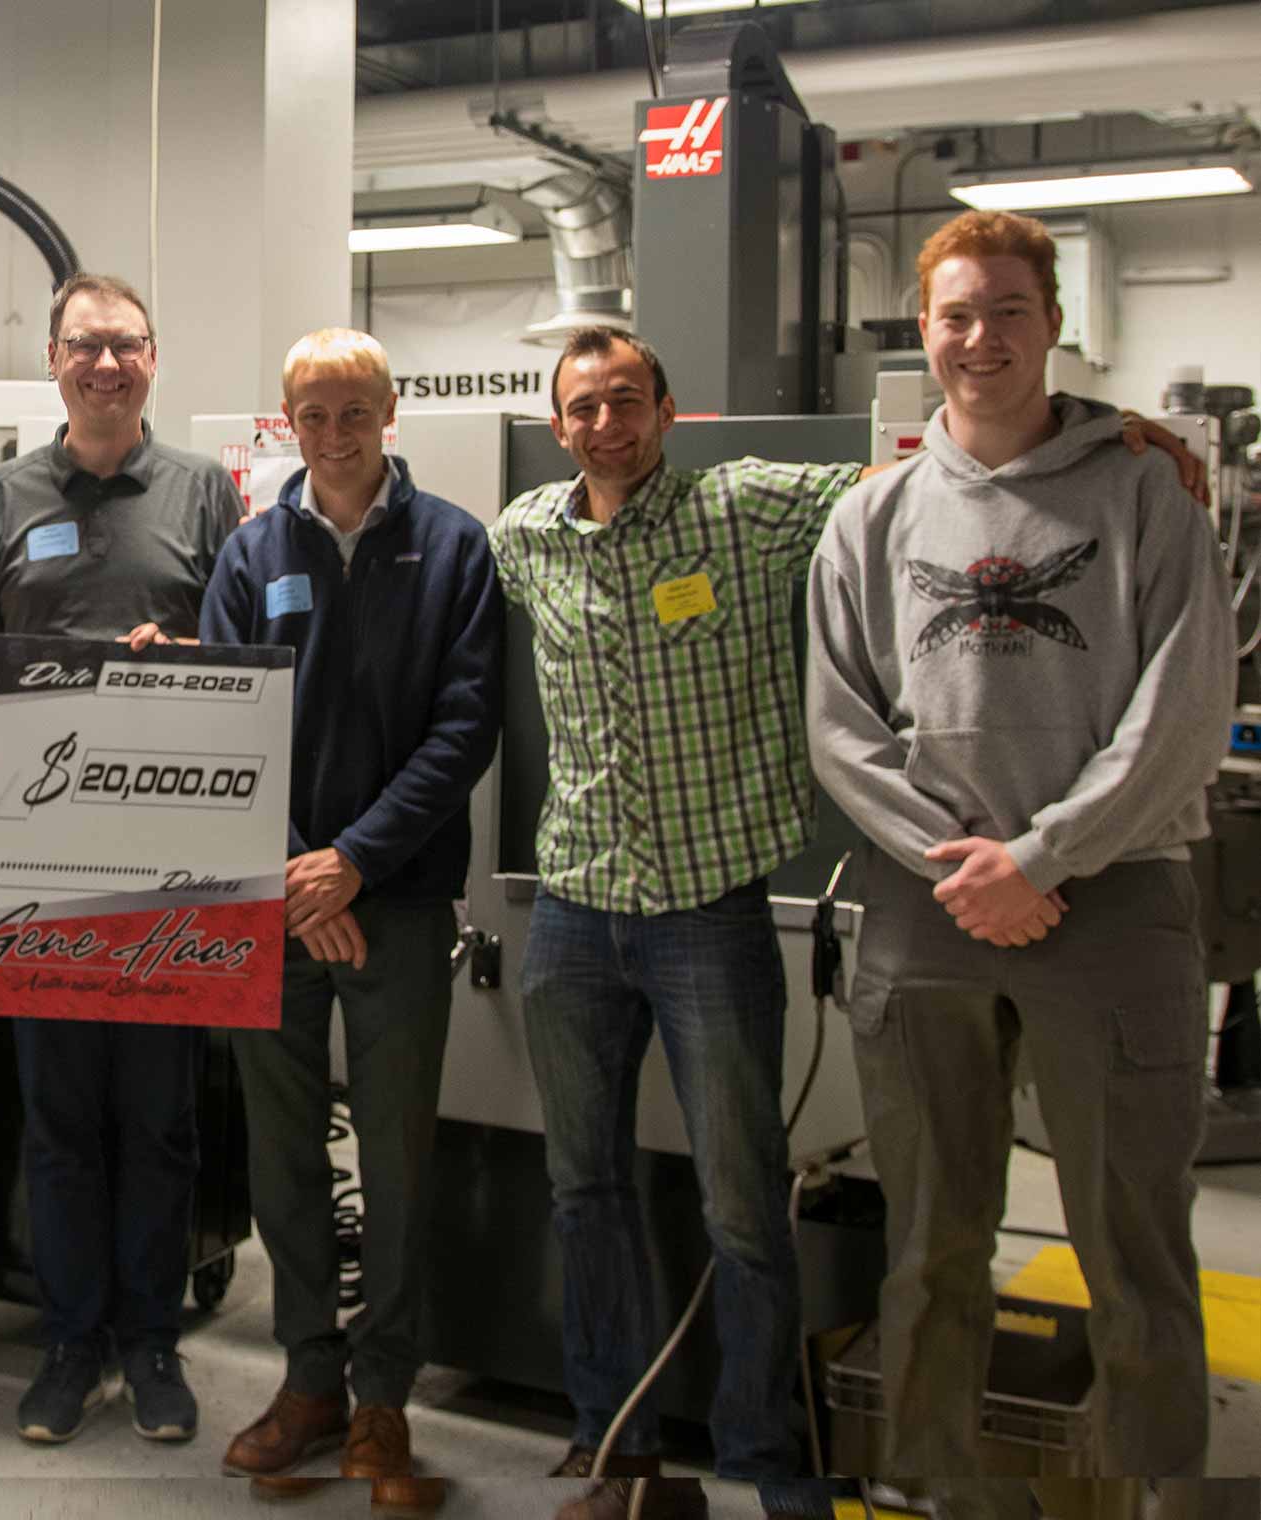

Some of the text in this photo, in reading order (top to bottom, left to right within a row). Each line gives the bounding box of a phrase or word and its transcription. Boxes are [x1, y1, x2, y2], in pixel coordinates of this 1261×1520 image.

[646, 150, 723, 175] HAAS
[106, 671, 254, 692] 2024-2025
[79, 763, 257, 800] 20,000.00
[111, 909, 256, 981] Haas
